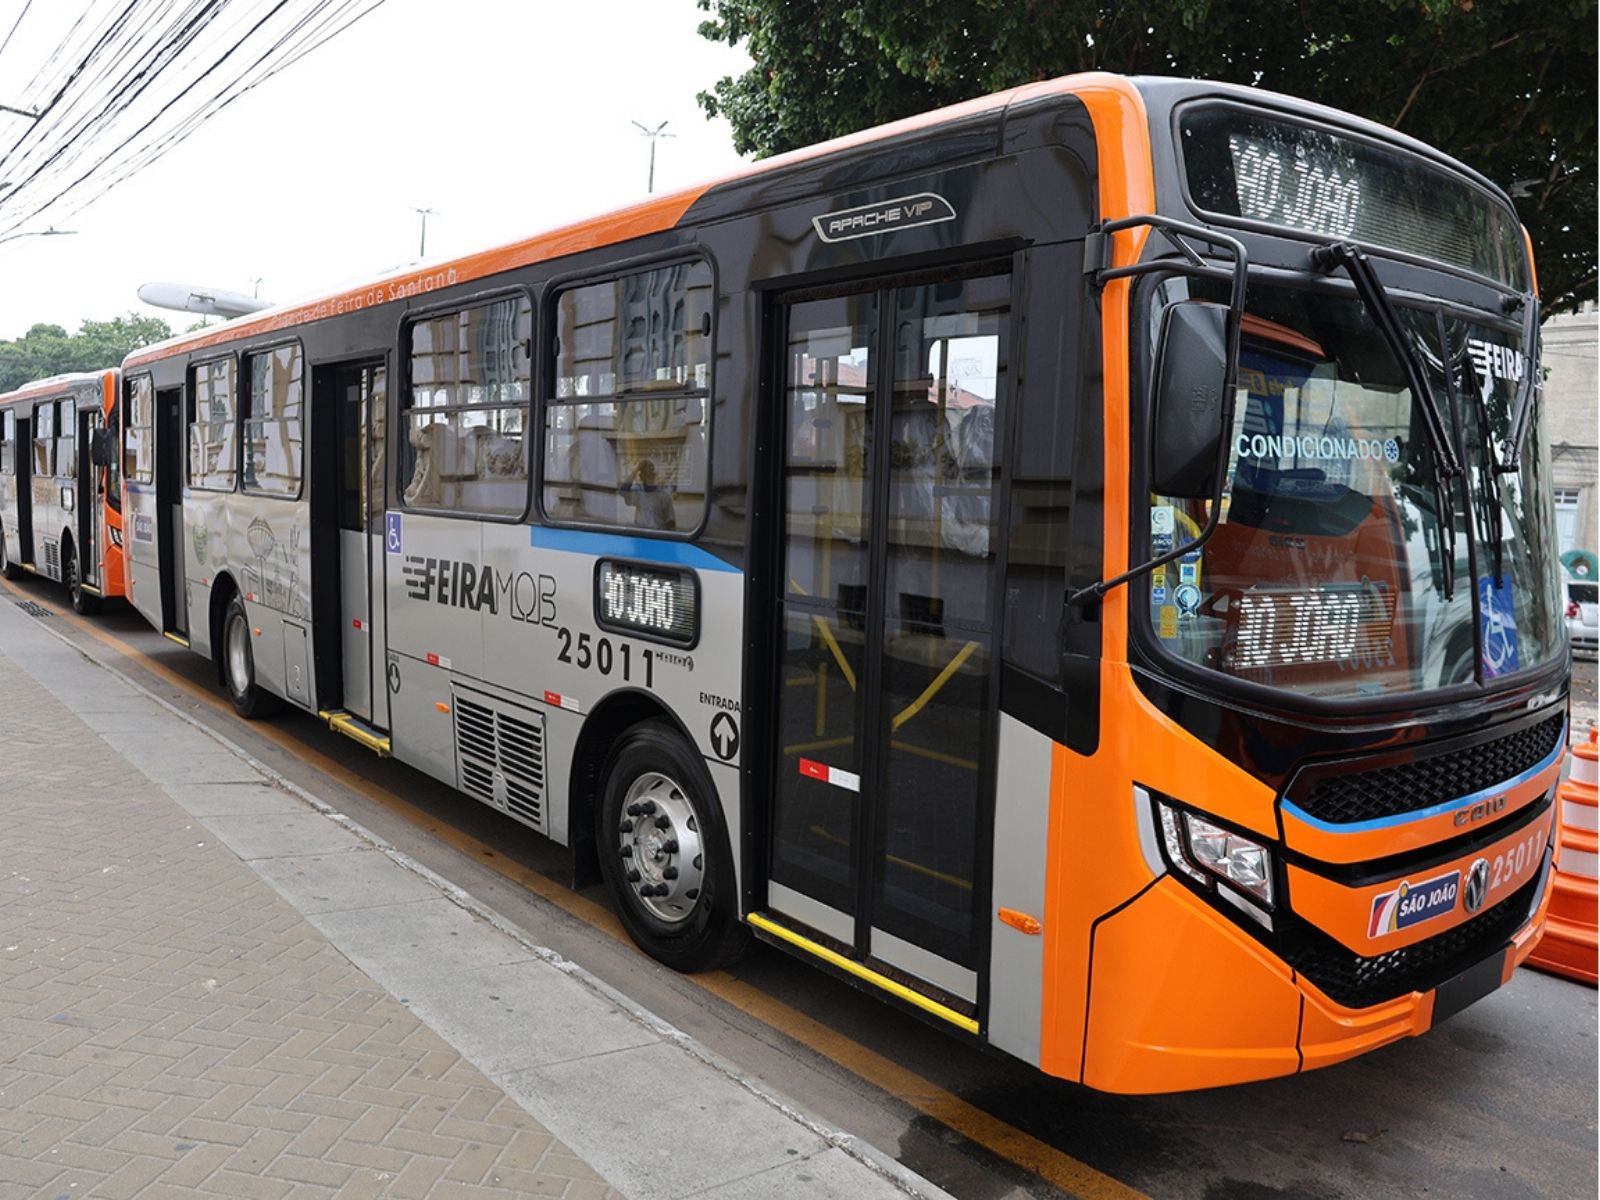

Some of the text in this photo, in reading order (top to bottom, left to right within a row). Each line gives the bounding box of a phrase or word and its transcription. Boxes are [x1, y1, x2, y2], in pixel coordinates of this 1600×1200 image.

[829, 201, 933, 233] APACHE VIP
[367, 289, 383, 305] de
[388, 268, 457, 301] Santana
[1236, 434, 1382, 460] CONDICIONADO
[557, 626, 654, 689] 25011
[699, 692, 742, 713] ENTRADA
[1489, 829, 1543, 890] 25011
[1399, 882, 1457, 917] SÃO JOÃO
